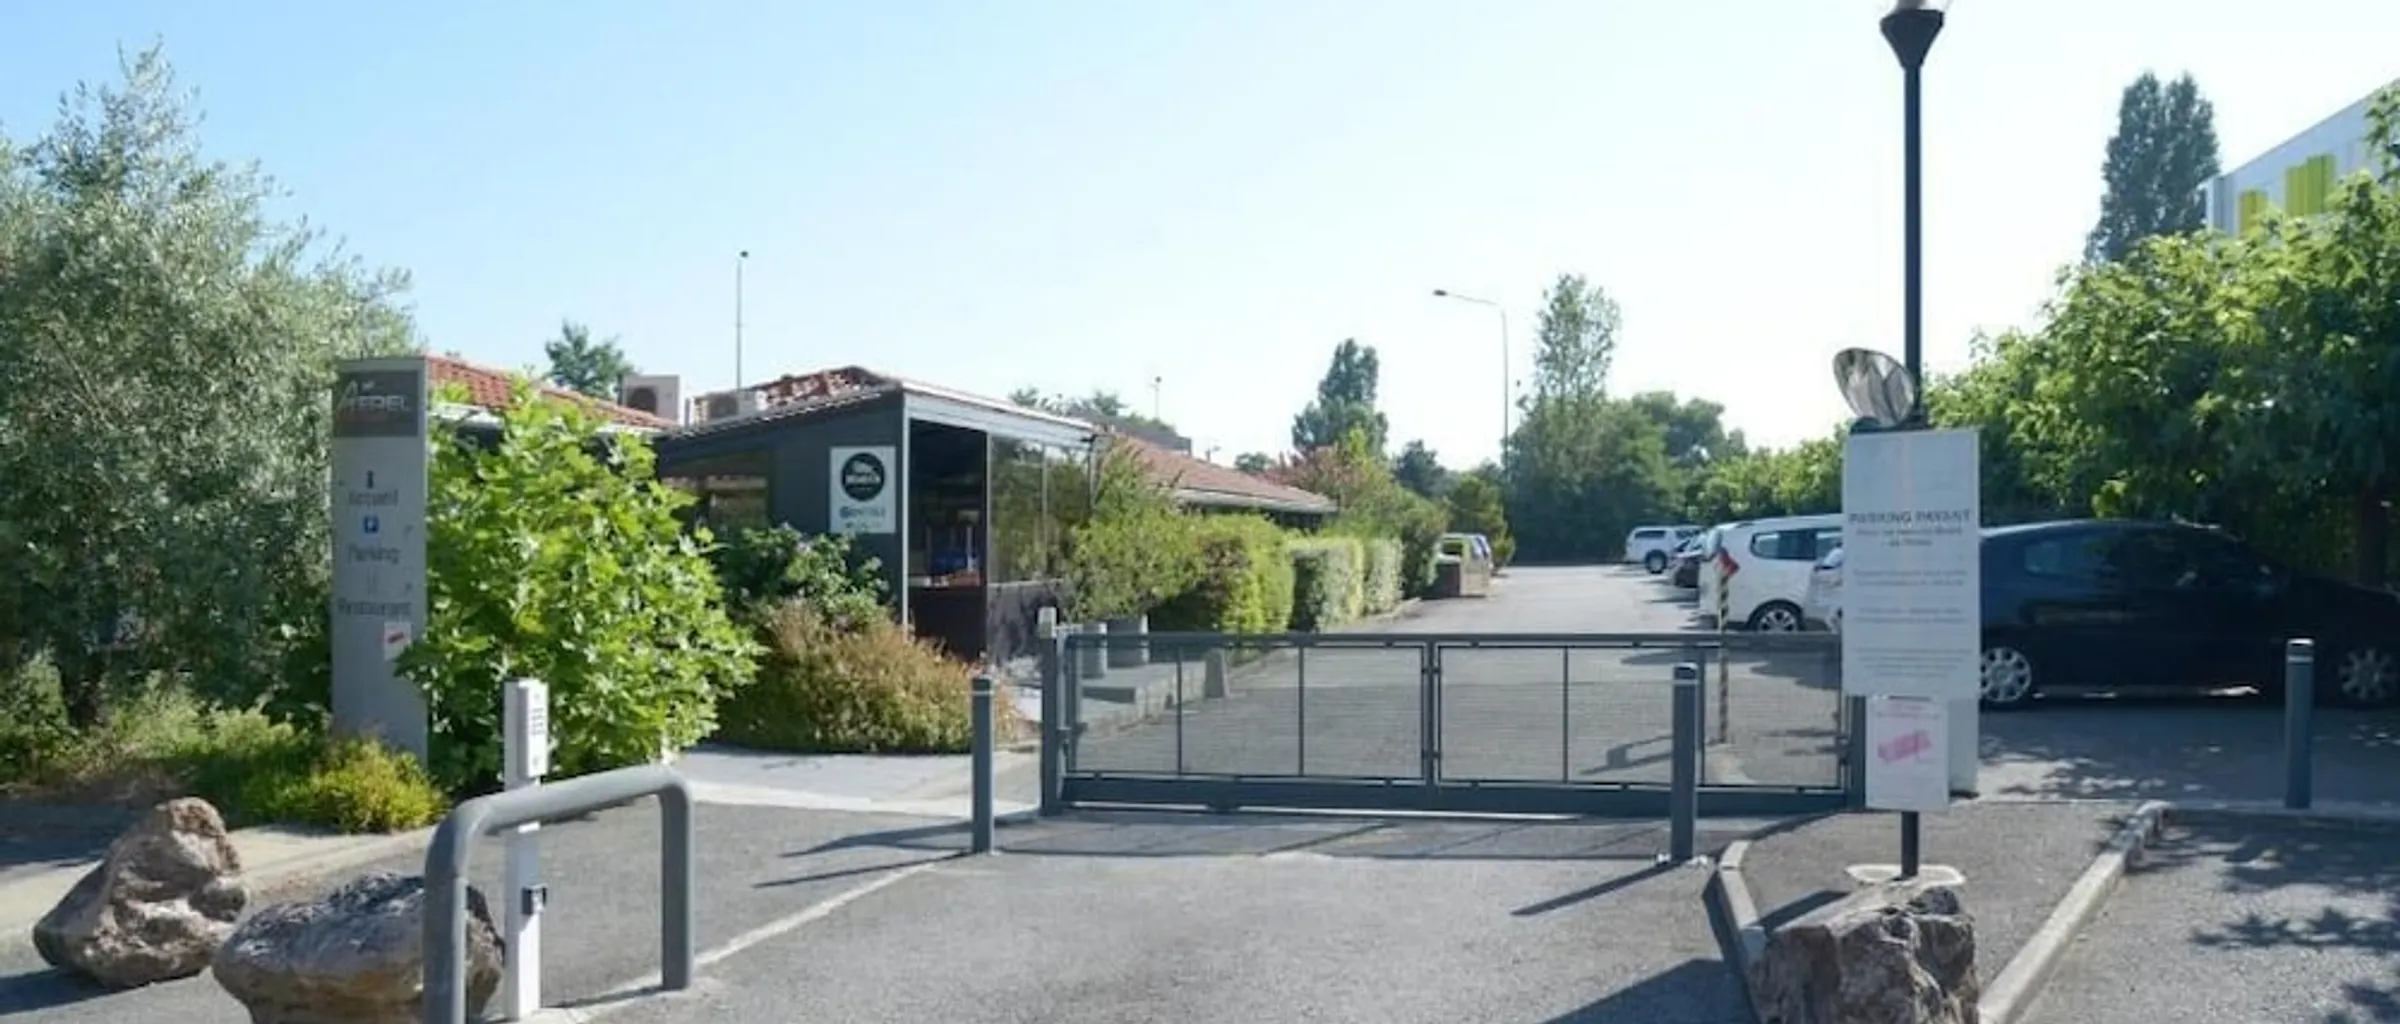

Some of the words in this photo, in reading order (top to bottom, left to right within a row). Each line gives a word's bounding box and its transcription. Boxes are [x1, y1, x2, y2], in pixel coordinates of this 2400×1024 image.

[1848, 510, 1912, 524] PARKING
[1915, 508, 1971, 521] PAYANT
[347, 543, 401, 566] Parking
[337, 598, 411, 616] Restaurant
